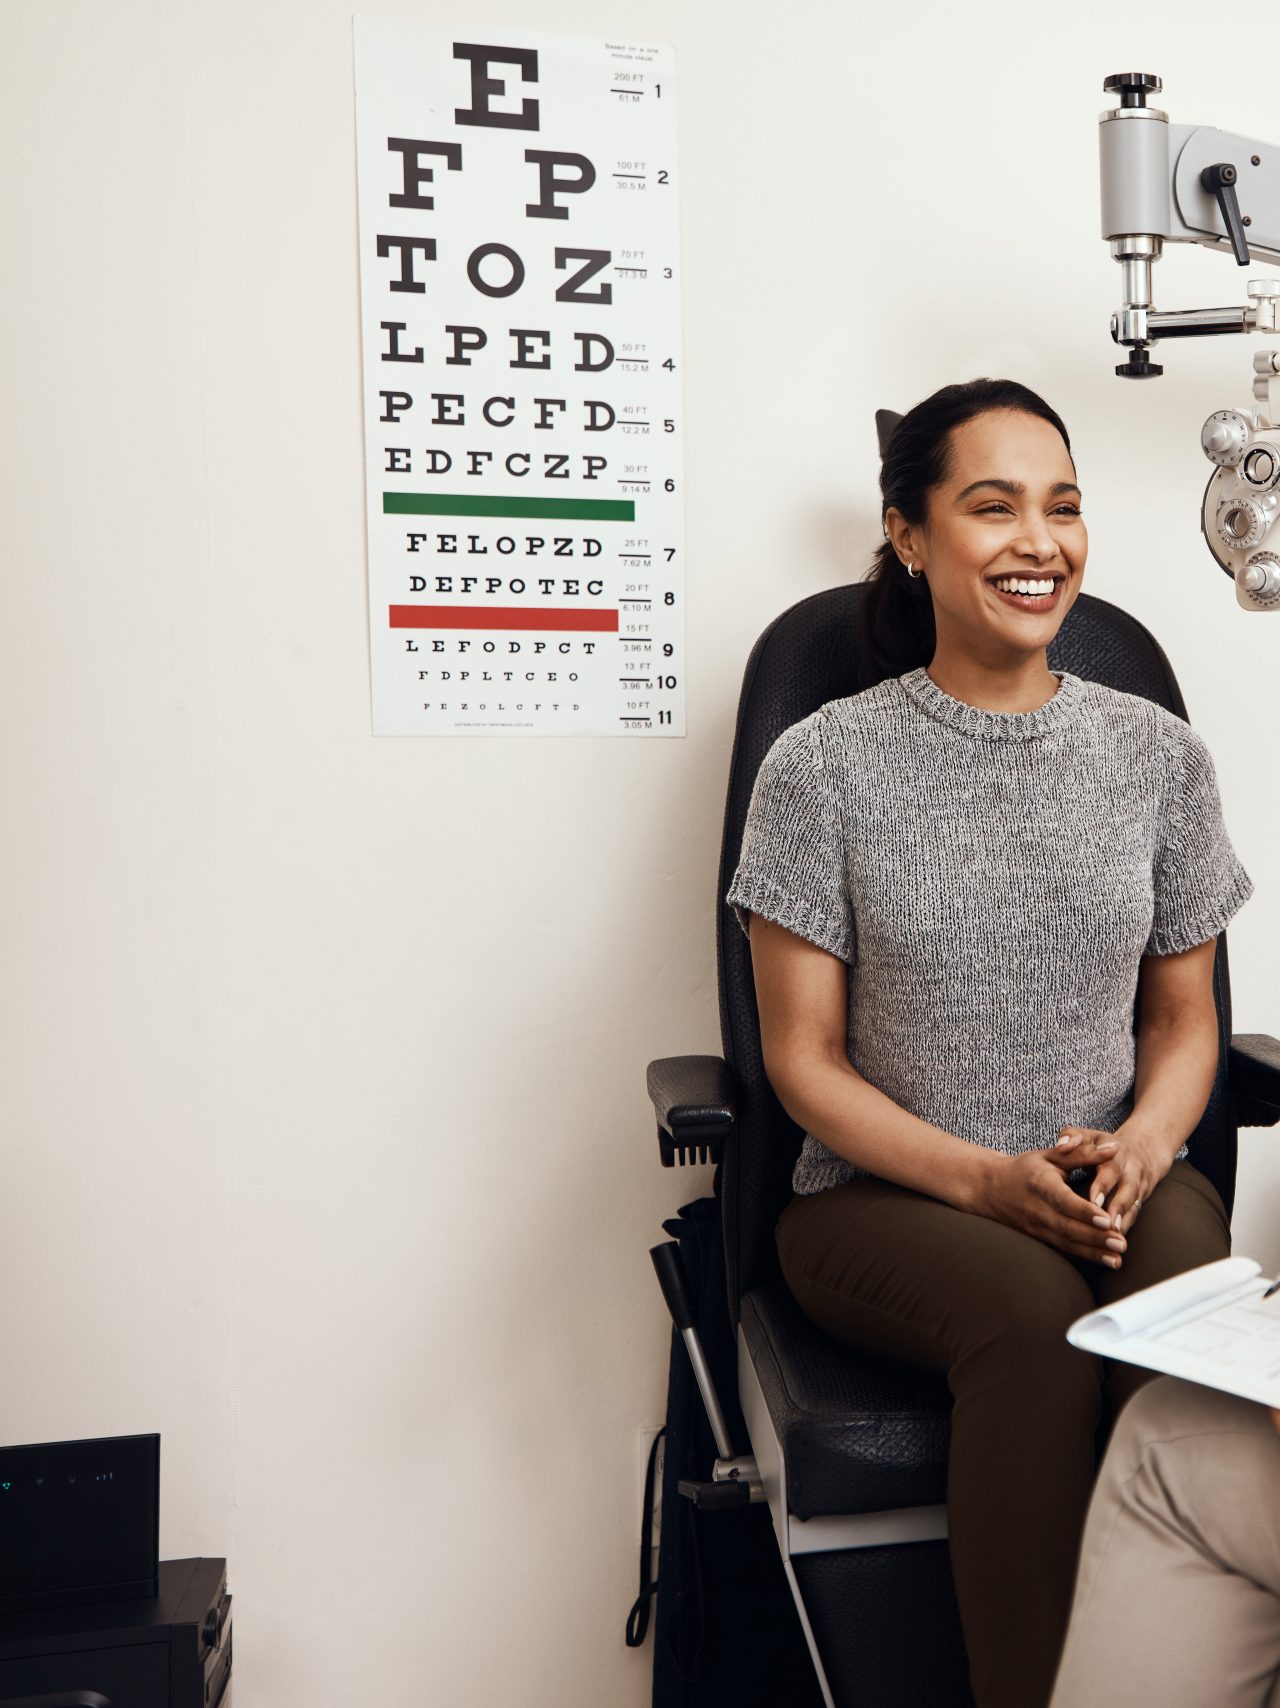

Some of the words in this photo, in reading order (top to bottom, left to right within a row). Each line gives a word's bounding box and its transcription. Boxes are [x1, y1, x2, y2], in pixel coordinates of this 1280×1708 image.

[614, 72, 631, 82] 200
[632, 73, 645, 83] FT
[453, 42, 540, 132] E
[654, 83, 661, 99] 1
[631, 95, 641, 103] M
[616, 161, 633, 170] 100
[633, 161, 646, 170] FT
[657, 169, 670, 185] 2
[637, 182, 646, 191] M
[620, 249, 632, 259] 70
[633, 250, 645, 259] FT
[639, 271, 648, 280] M
[663, 267, 673, 279] 3
[621, 343, 633, 352] 50
[634, 343, 646, 352] FT
[640, 364, 649, 373] M
[661, 357, 677, 373] 4
[622, 405, 634, 415] 40
[635, 406, 647, 415] FT
[641, 426, 650, 435] M
[663, 418, 676, 434] 5
[623, 464, 635, 474] 30
[636, 465, 649, 473] FT
[642, 485, 651, 494] M
[663, 478, 676, 493] 6
[624, 538, 636, 548] 25
[637, 539, 649, 548] FT
[663, 547, 677, 563] 7
[643, 559, 652, 568] M
[625, 583, 636, 592] 20
[637, 583, 649, 592] FT
[663, 591, 676, 607] 8
[643, 603, 652, 613] M
[625, 623, 637, 633] 15
[637, 624, 650, 633] FT
[643, 644, 652, 653] M
[662, 642, 674, 658] 9
[624, 662, 635, 671] 13
[639, 662, 652, 671] FT
[645, 681, 654, 691] M
[656, 675, 678, 690] 10
[626, 701, 637, 710] 10
[638, 700, 651, 710] FT
[657, 709, 672, 725] 11
[644, 720, 653, 729] M
